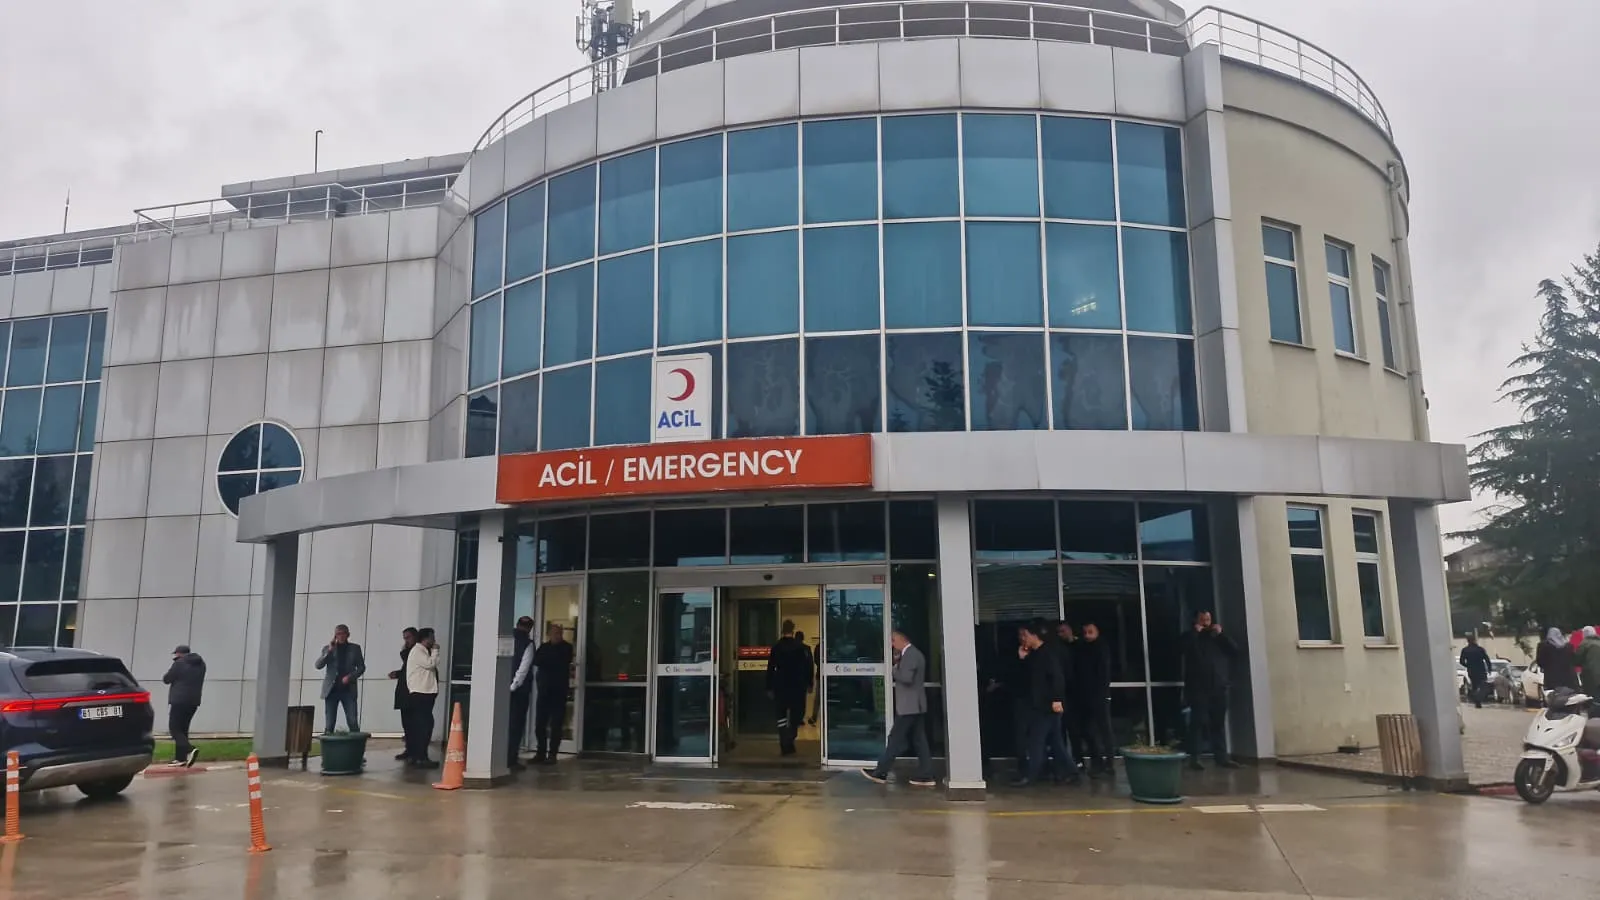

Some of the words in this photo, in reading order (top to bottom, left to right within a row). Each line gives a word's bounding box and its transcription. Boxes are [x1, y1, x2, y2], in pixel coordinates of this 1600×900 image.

[537, 454, 597, 488] ACİL
[604, 458, 614, 487] /
[623, 449, 803, 482] EMERGENCY
